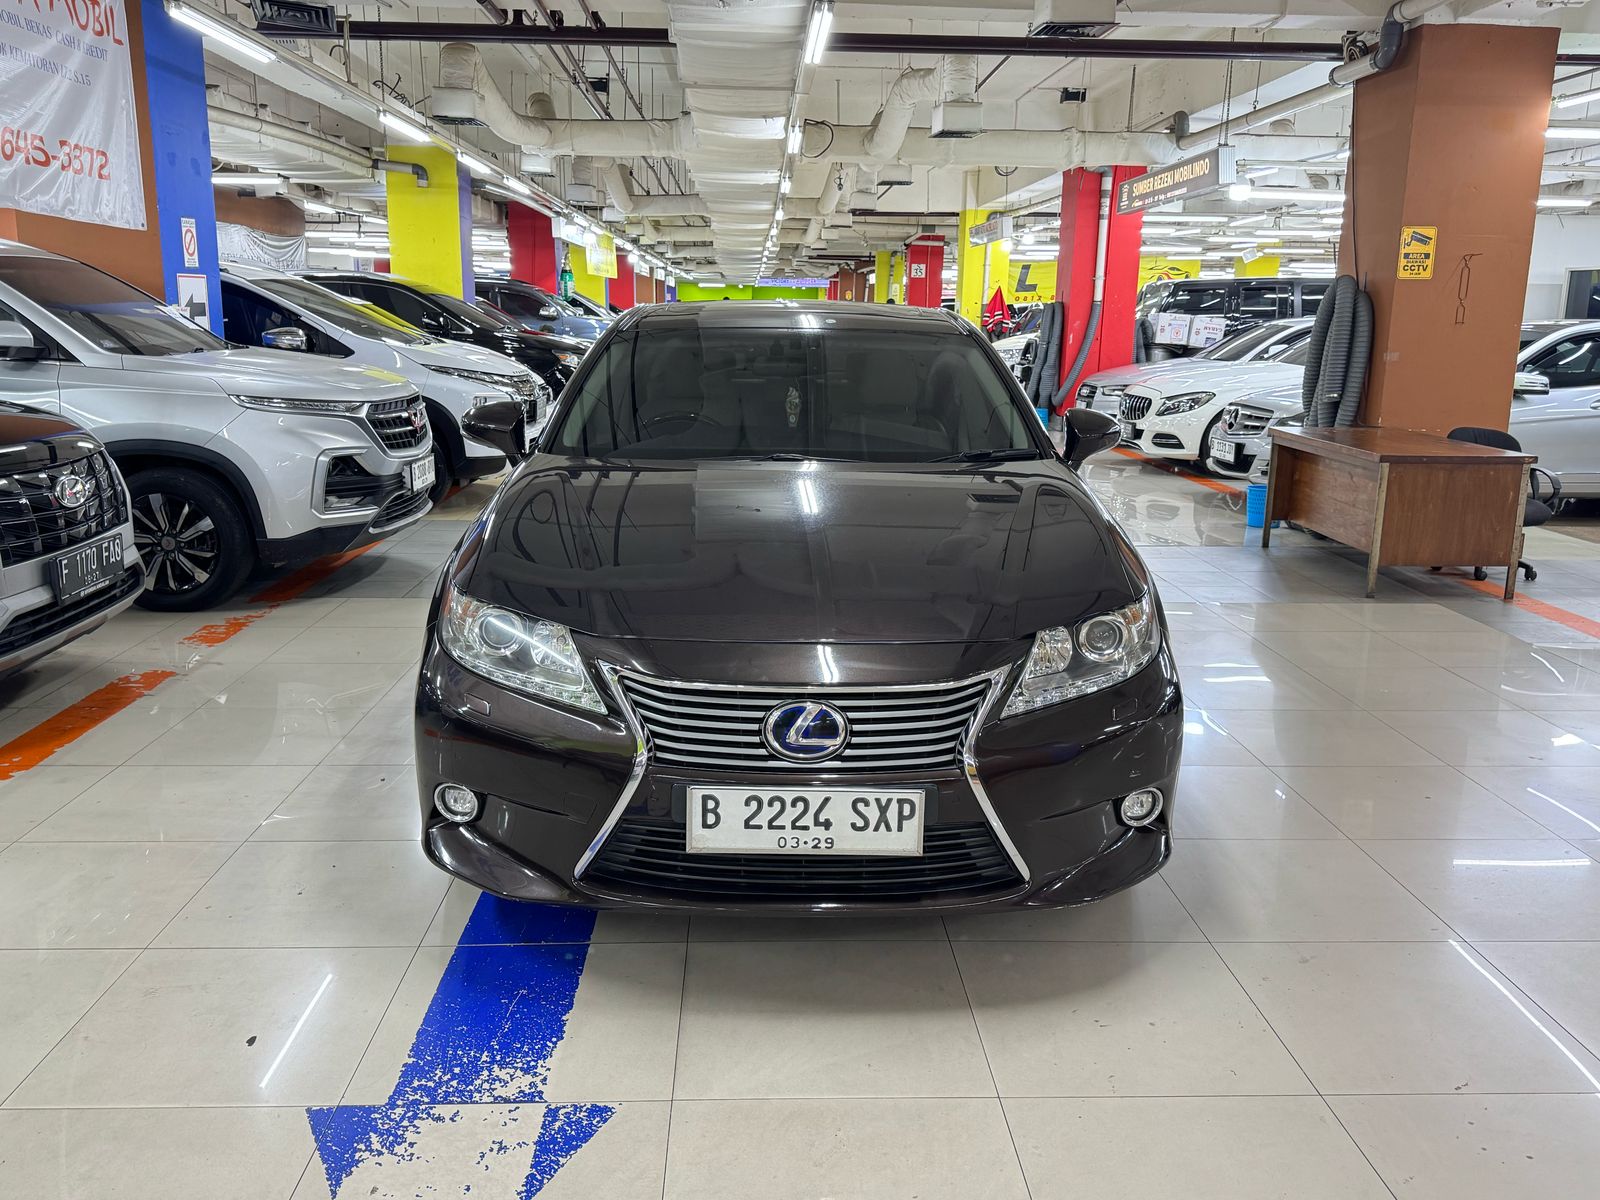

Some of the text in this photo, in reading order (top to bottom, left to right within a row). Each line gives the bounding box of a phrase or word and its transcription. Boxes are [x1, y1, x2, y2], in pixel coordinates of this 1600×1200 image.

[24, 17, 53, 40] BEKAS
[55, 30, 76, 50] CASH
[9, 45, 59, 75] KEMAYORAN
[1133, 175, 1154, 197] SUMBER
[1154, 170, 1173, 190] REZEKI
[1174, 158, 1210, 184] MOBILINDO
[61, 559, 69, 585] F
[76, 546, 97, 577] 1170
[701, 793, 917, 833] B 2224 SXP
